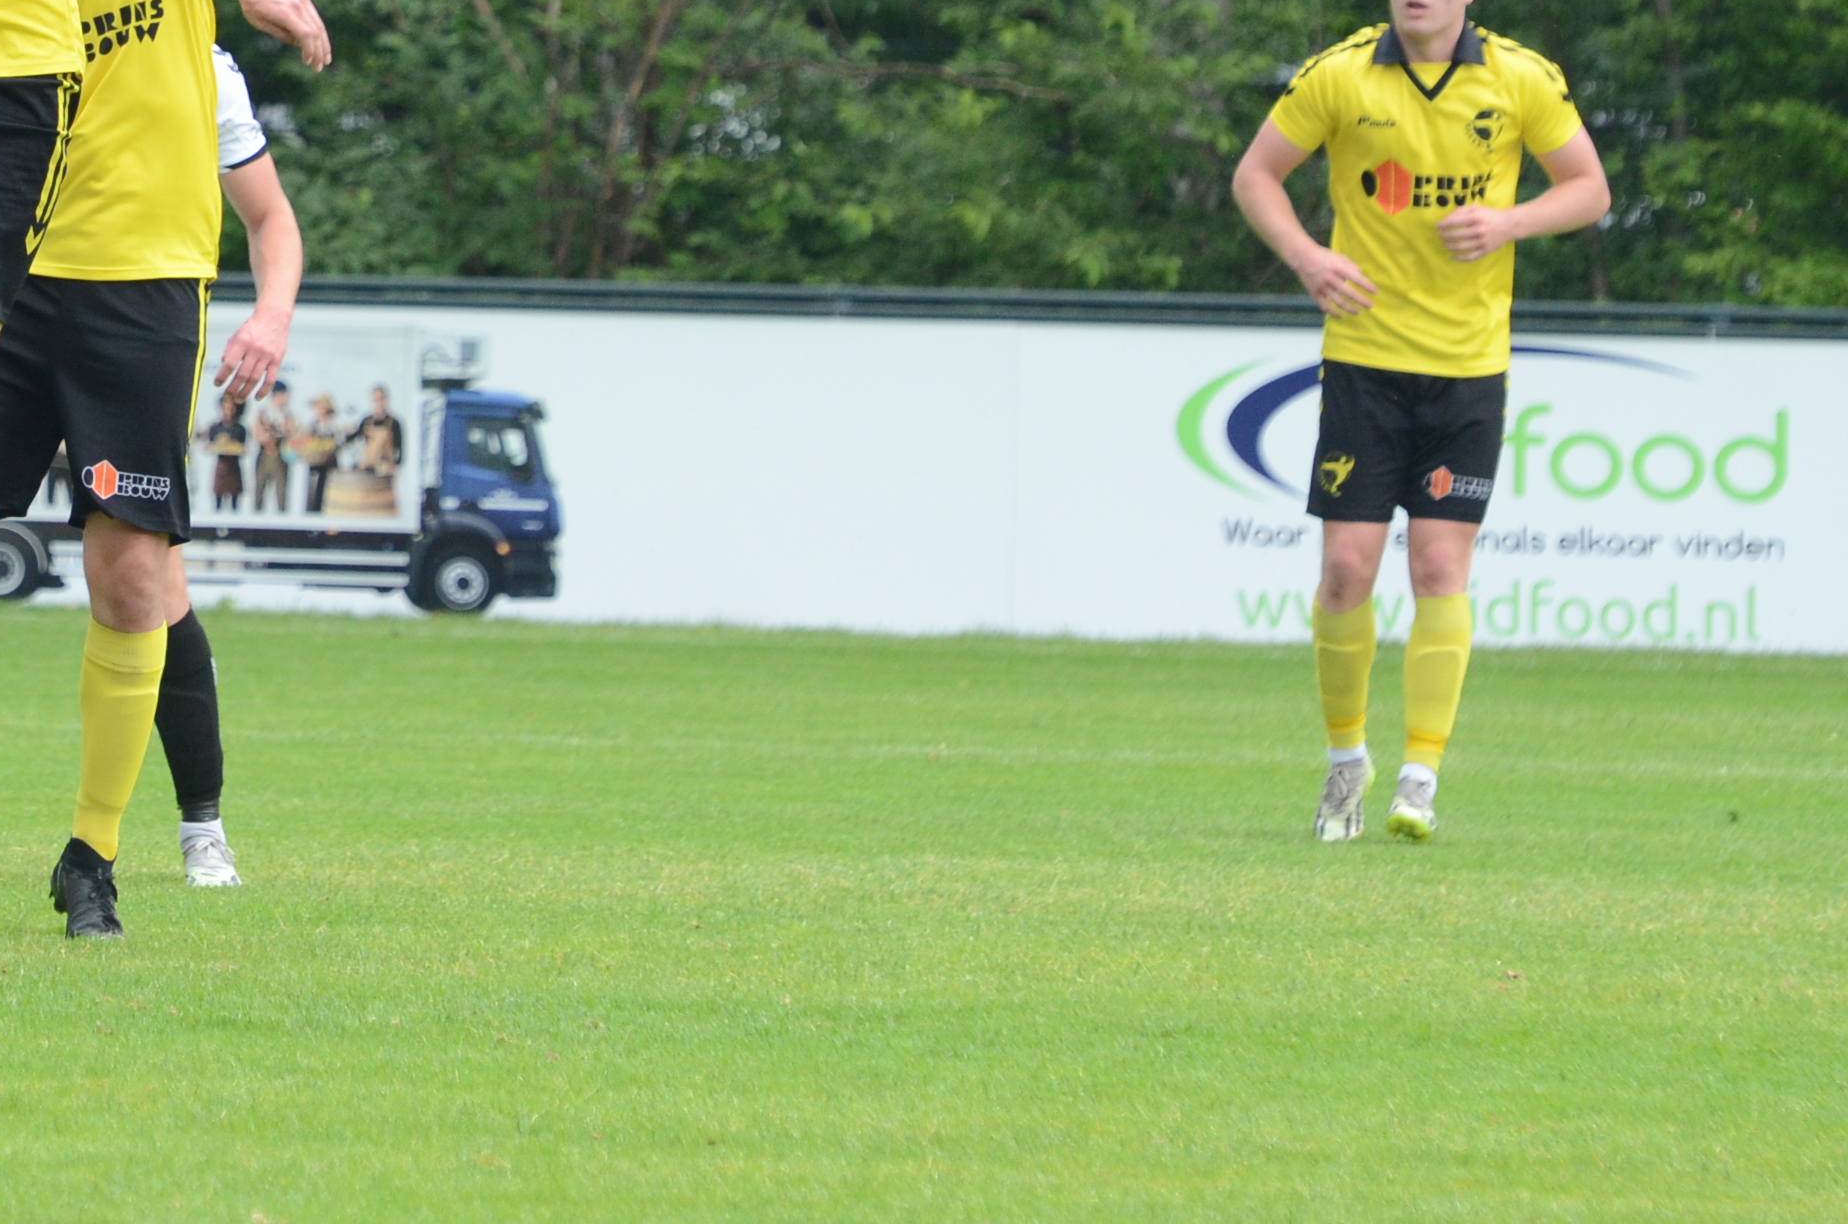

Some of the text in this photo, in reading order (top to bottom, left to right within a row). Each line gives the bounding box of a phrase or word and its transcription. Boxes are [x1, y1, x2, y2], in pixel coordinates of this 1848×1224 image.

[1504, 403, 1790, 504] food
[115, 483, 169, 501] BOUW
[116, 472, 170, 489] PRINS
[1223, 516, 1309, 549] Waar
[1558, 524, 1660, 559] elkaar
[1674, 528, 1785, 561] vinden
